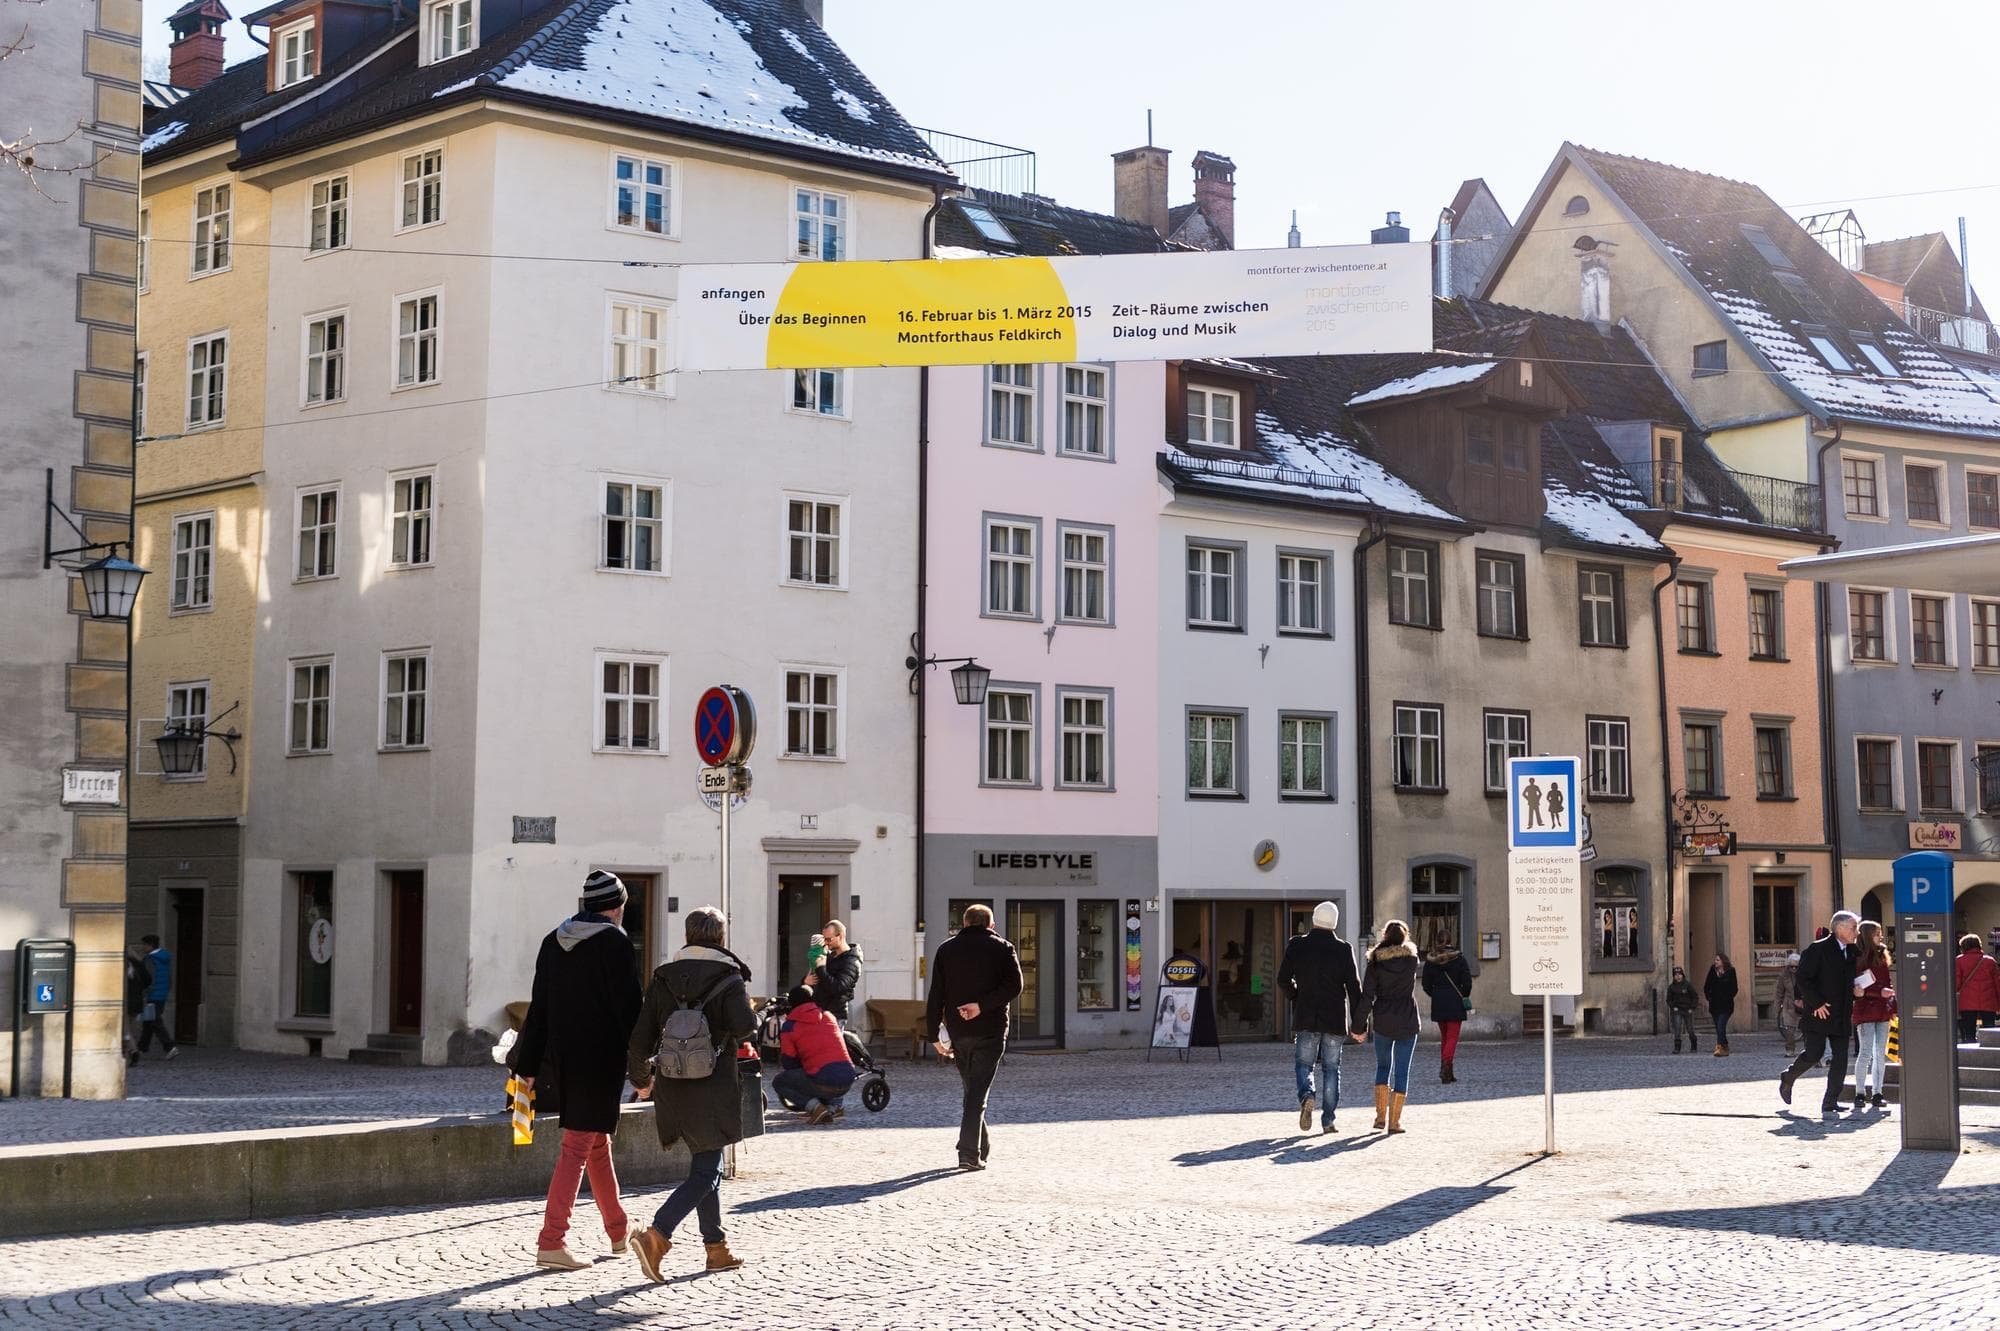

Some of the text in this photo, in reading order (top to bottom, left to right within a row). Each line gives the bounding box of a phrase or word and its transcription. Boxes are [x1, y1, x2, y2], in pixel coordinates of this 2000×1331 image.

[1247, 262, 1387, 275] montforter-zwischentoene.at
[702, 288, 765, 301] anfangen
[1305, 284, 1386, 299] montforter
[898, 306, 1091, 322] 16. Februar bis 1. März 2015
[1112, 301, 1269, 317] Zeit-Räume zwischen
[1305, 300, 1410, 316] zwischentöne
[739, 311, 866, 327] Über das Beginnen
[1306, 319, 1336, 332] 2015
[898, 328, 1061, 343] Montforthaus Feldkirch
[1113, 323, 1237, 339] Dialog und Musik
[705, 773, 725, 787] Ende
[979, 854, 1092, 868] LIFESTYLE
[1515, 857, 1573, 865] Ladetätigkeiten
[1527, 867, 1562, 875] werktags
[1560, 876, 1574, 884] Uhr
[1912, 877, 1931, 904] P
[1523, 925, 1567, 933] Berechtigte
[1529, 982, 1564, 990] gestattet
